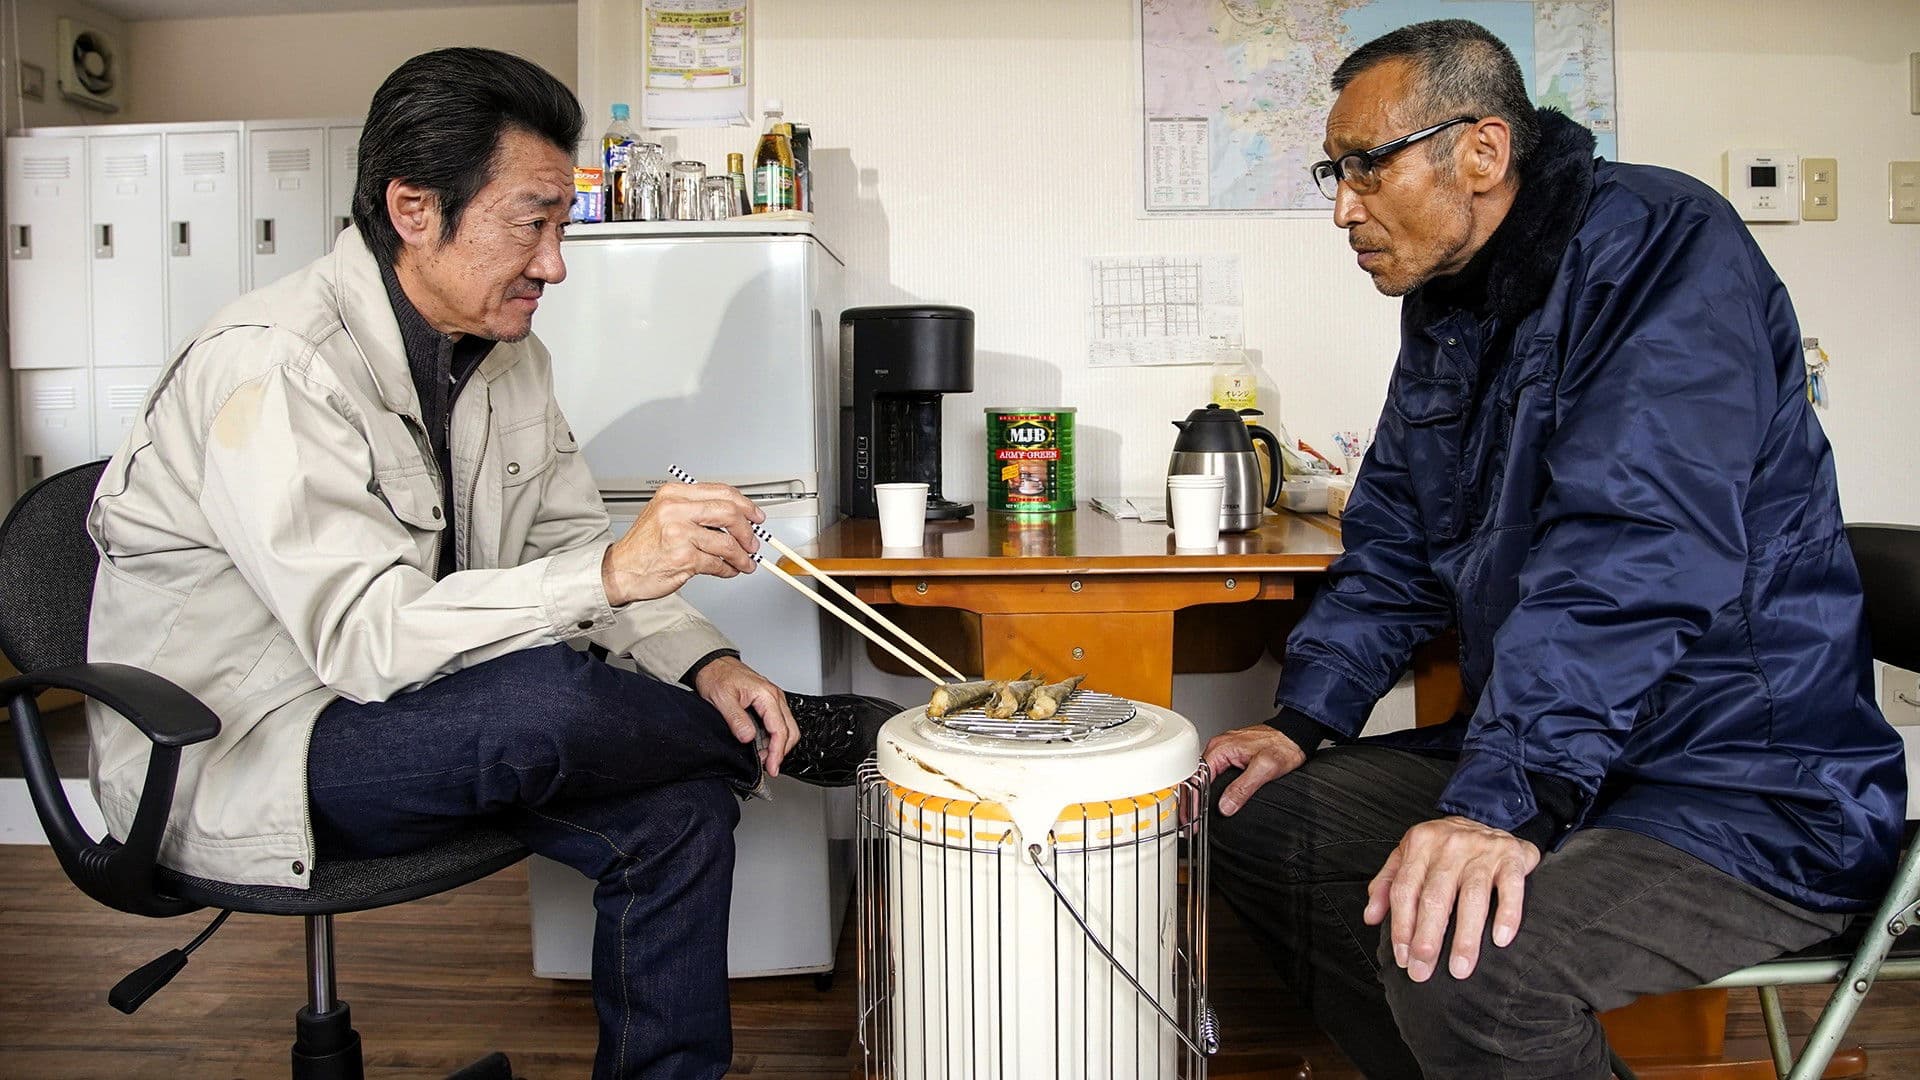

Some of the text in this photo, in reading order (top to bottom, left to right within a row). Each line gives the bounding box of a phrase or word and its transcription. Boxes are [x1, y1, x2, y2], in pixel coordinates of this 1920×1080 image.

[1225, 390, 1250, 398] オレンジ
[1010, 428, 1046, 442] MJB
[1000, 451, 1057, 459] ARMY GREEN
